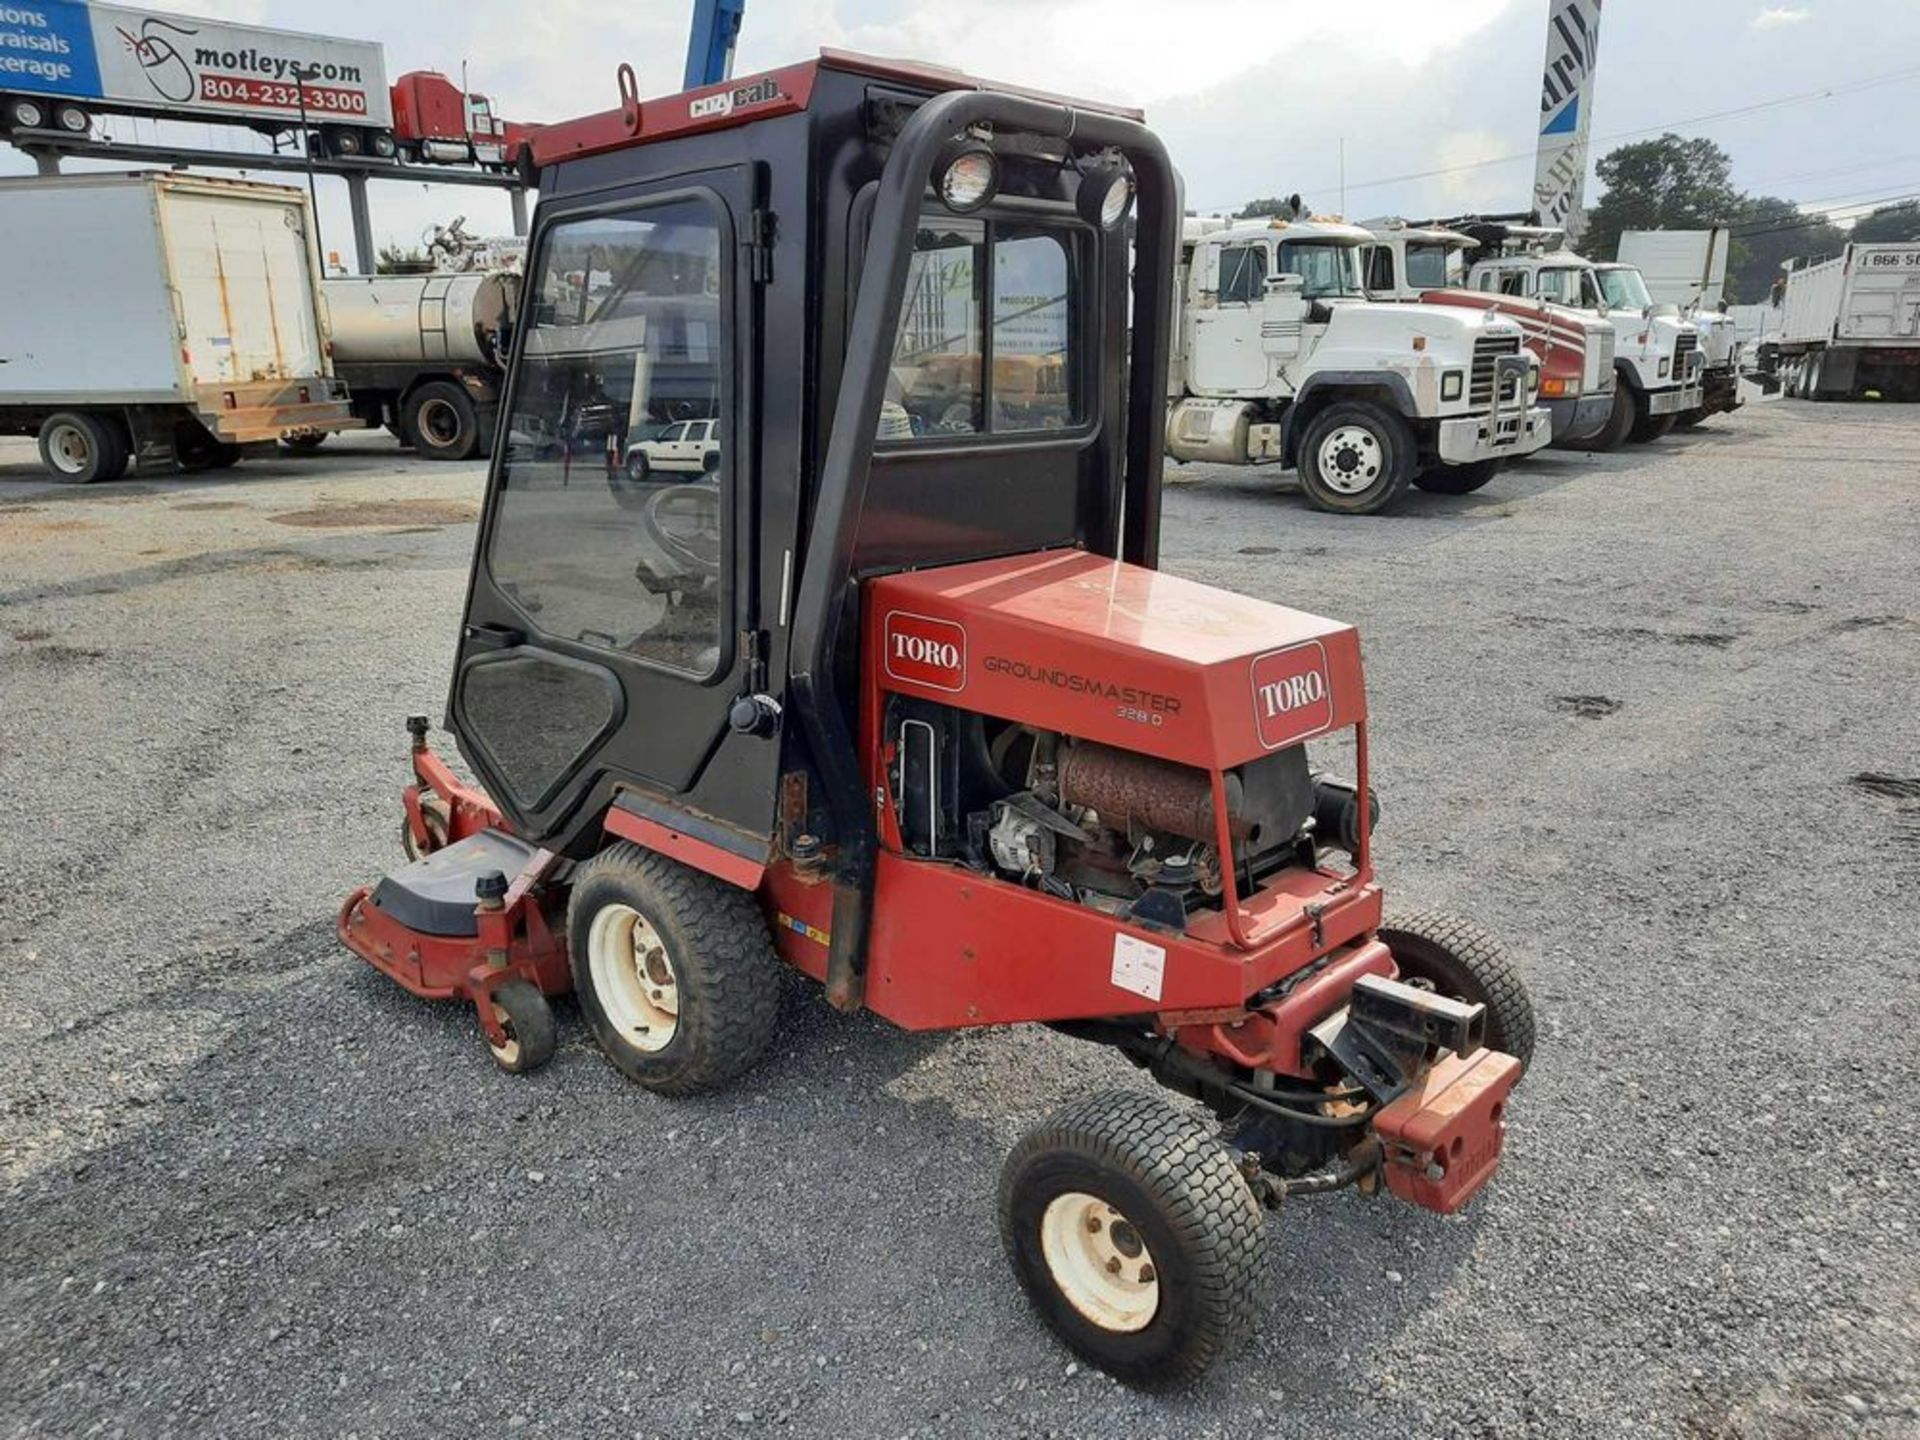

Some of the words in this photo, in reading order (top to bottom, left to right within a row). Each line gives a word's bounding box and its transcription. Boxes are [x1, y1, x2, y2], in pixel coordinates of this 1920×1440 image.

[195, 47, 361, 84] motleyscom
[203, 79, 365, 112] 804-232-3300
[892, 632, 959, 669] TORO
[982, 655, 1182, 714] GROUNDSMASTER
[1259, 670, 1323, 717] TORO
